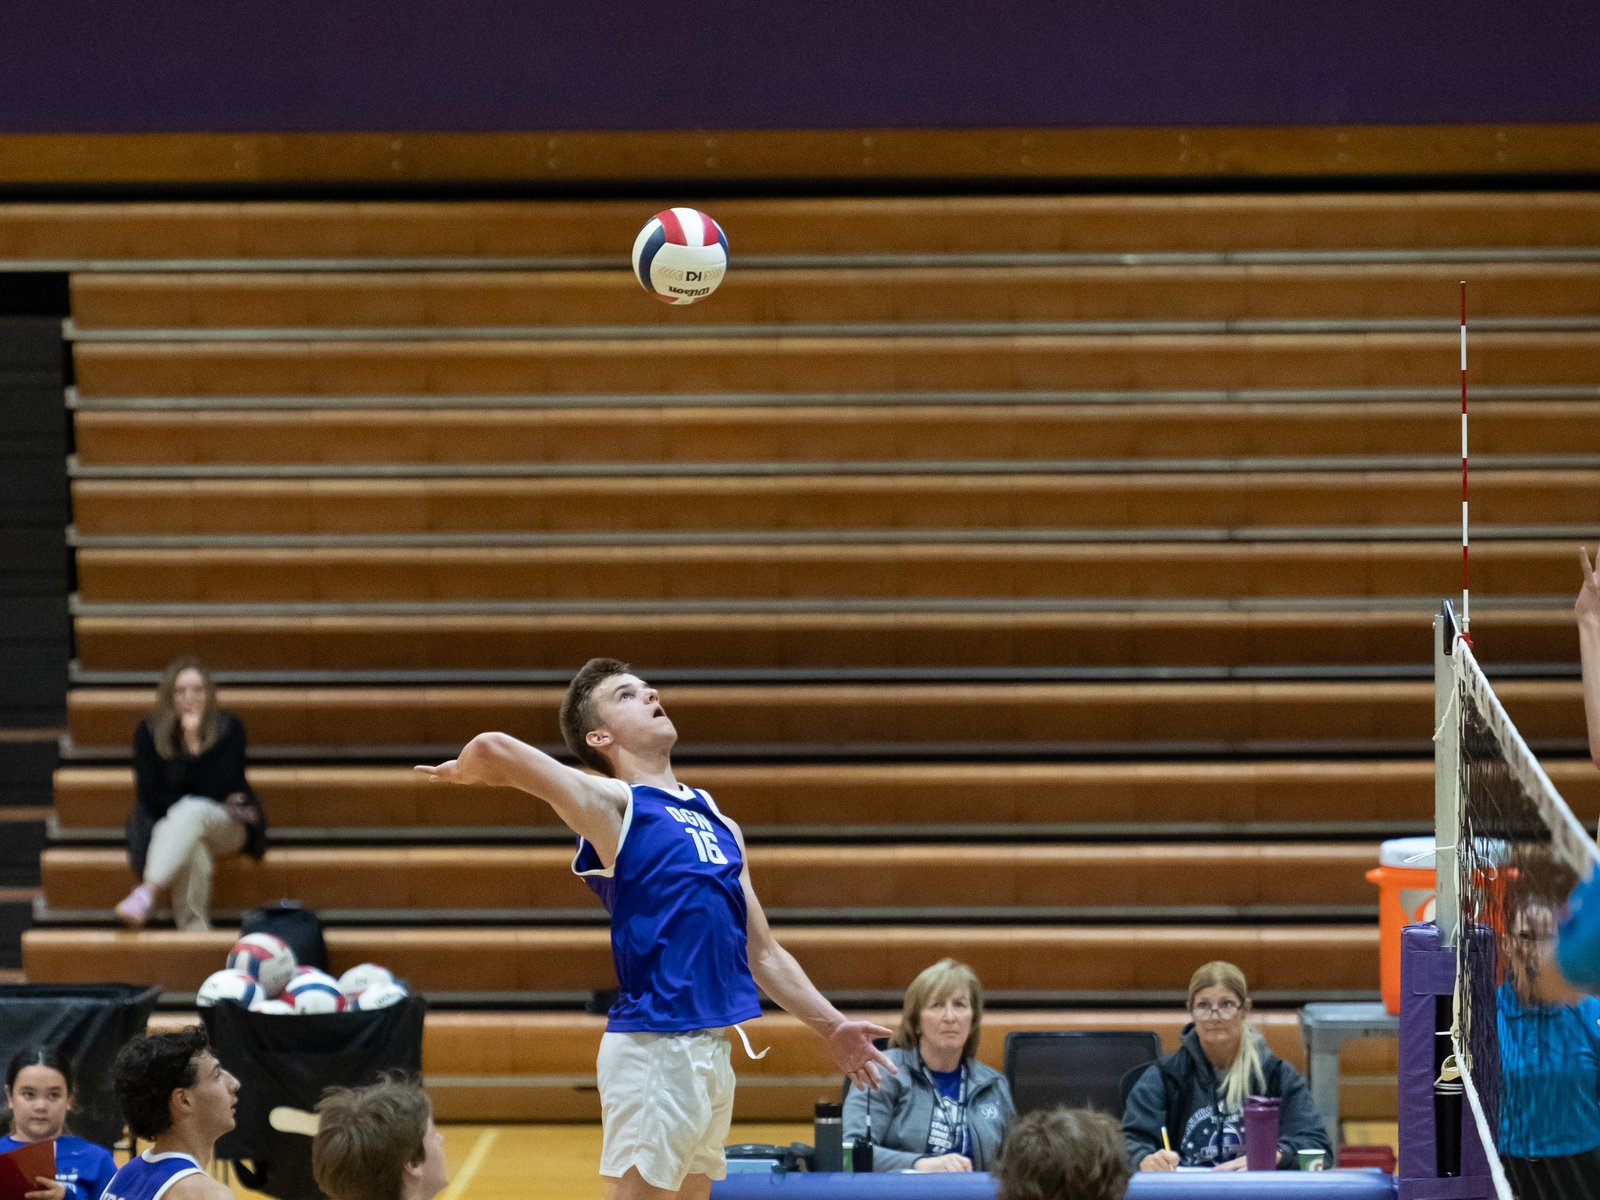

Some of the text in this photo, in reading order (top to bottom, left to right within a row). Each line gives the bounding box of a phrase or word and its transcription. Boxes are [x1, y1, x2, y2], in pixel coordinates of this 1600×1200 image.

[668, 285, 710, 297] Wilson
[664, 806, 714, 833] DGN
[685, 827, 729, 865] 16
